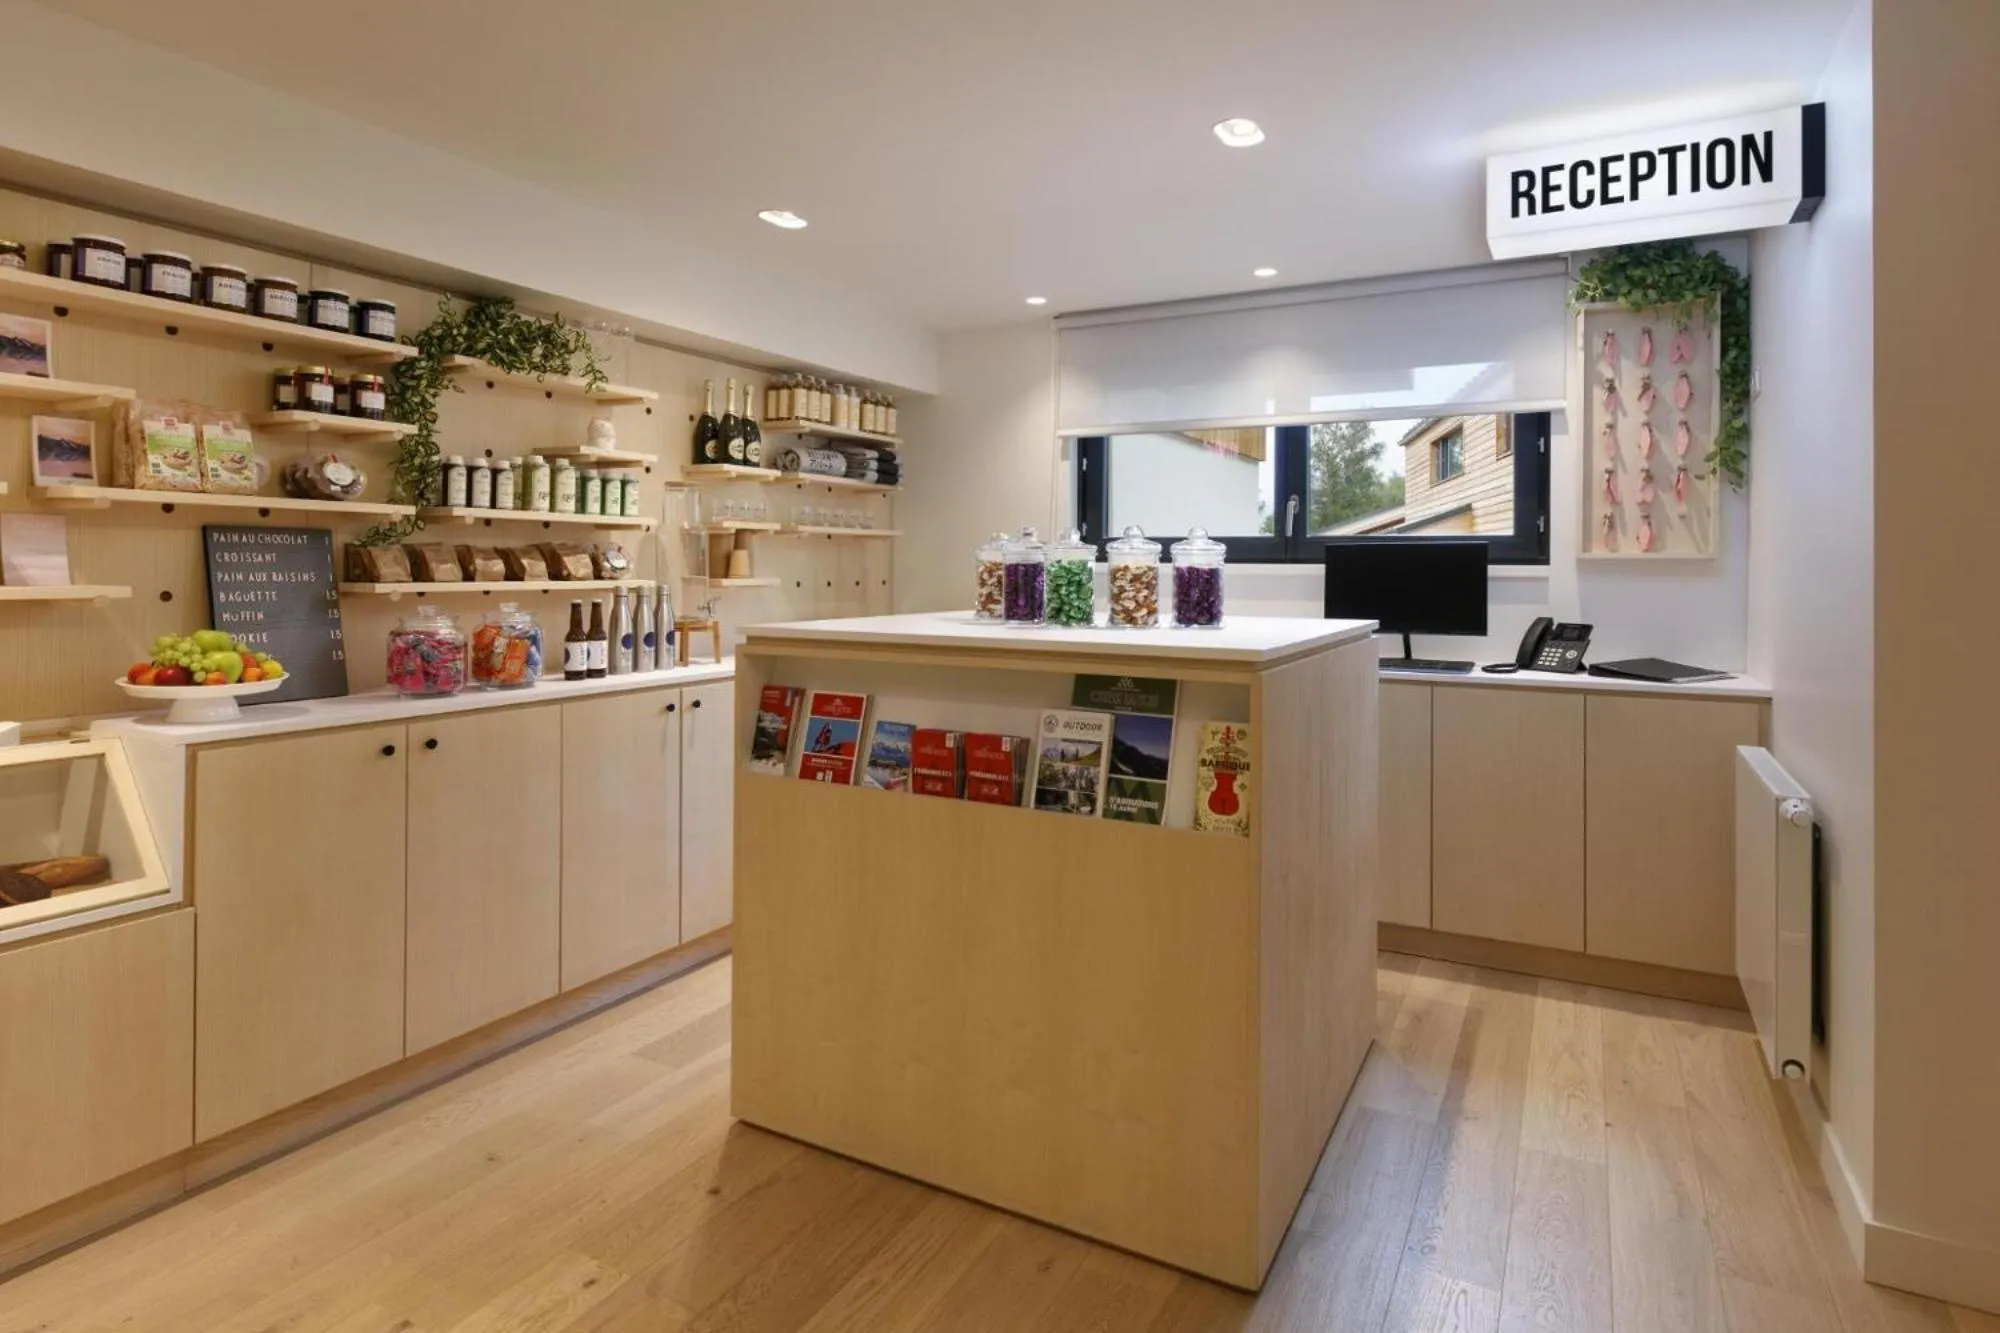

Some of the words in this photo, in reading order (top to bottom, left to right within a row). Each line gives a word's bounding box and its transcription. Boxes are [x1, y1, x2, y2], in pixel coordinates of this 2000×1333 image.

[1511, 130, 1773, 218] RECEPTION
[213, 532, 239, 543] PAIN
[242, 533, 255, 544] AU
[258, 533, 308, 545] CHOCOLAT
[215, 552, 276, 562] CROISSANT
[216, 571, 243, 582] PAIN
[249, 571, 267, 581] AUX
[272, 571, 316, 582] RAISINS
[219, 591, 278, 602] BAGUETTE
[222, 610, 264, 621] MUFFIN
[231, 632, 268, 643] OOKIE
[1063, 720, 1103, 731] OUTDOOR
